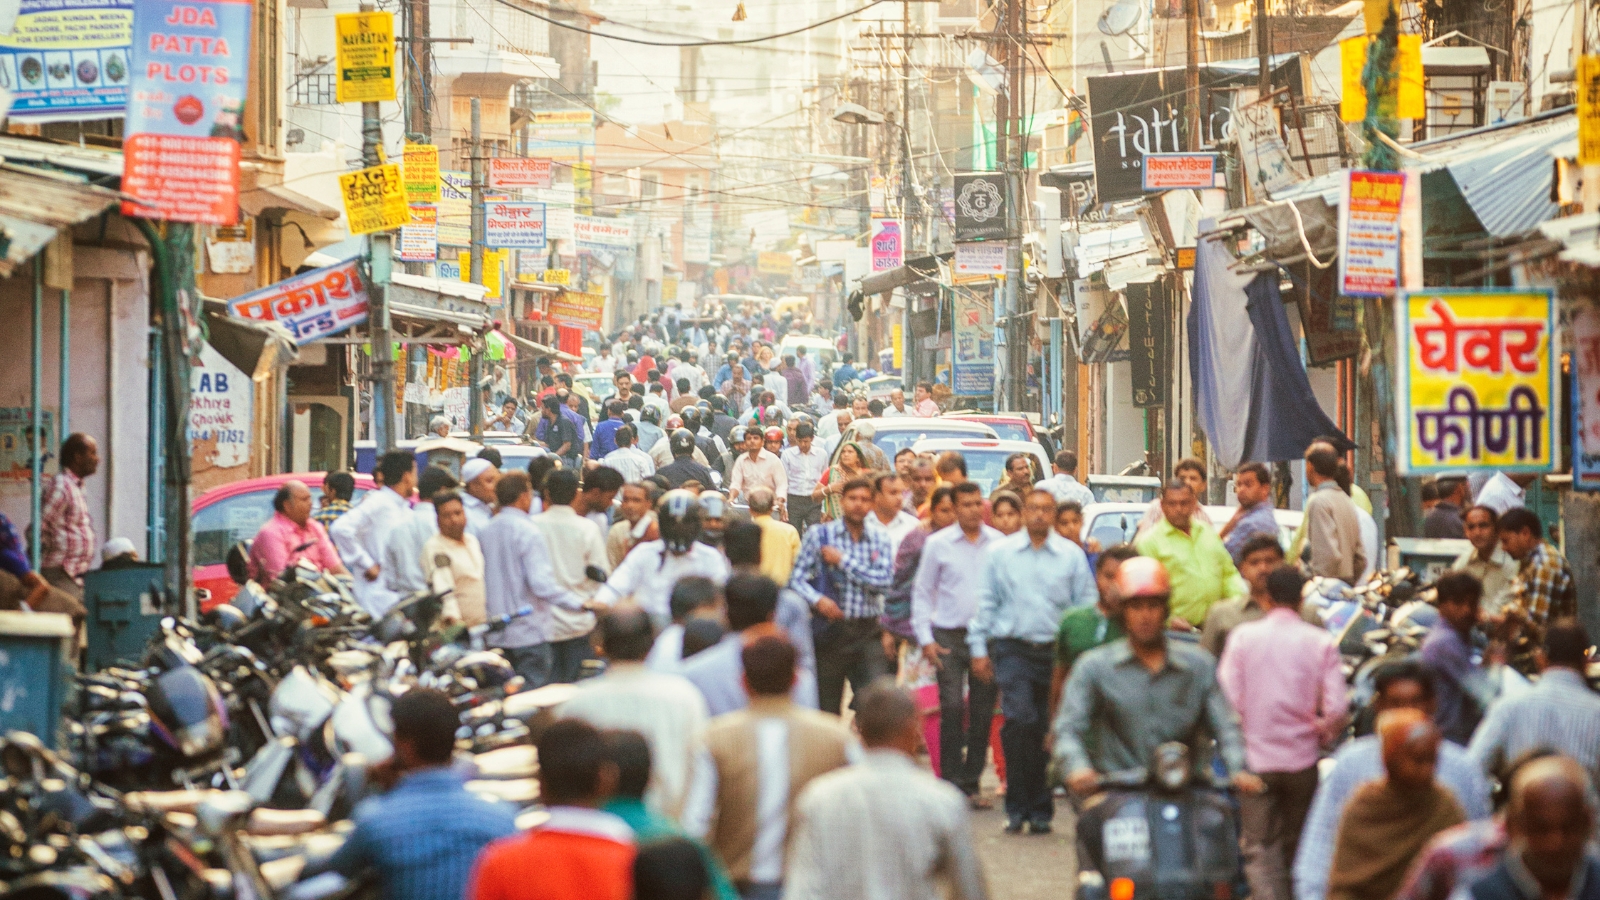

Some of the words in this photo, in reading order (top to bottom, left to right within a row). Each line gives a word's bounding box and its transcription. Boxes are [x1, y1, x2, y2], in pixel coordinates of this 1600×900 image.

[166, 6, 216, 27] JDA
[34, 34, 79, 42] EXHIBITION
[150, 33, 230, 56] PATTA
[342, 32, 388, 45] NAVRATAN
[147, 61, 229, 85] PLOTS
[492, 159, 518, 171] विकास
[1148, 156, 1177, 171] विकास
[340, 165, 398, 190] PACE
[876, 238, 896, 252] शादी
[1414, 299, 1546, 373] घेवर
[191, 373, 229, 394] AB
[1415, 386, 1545, 461] फीणी
